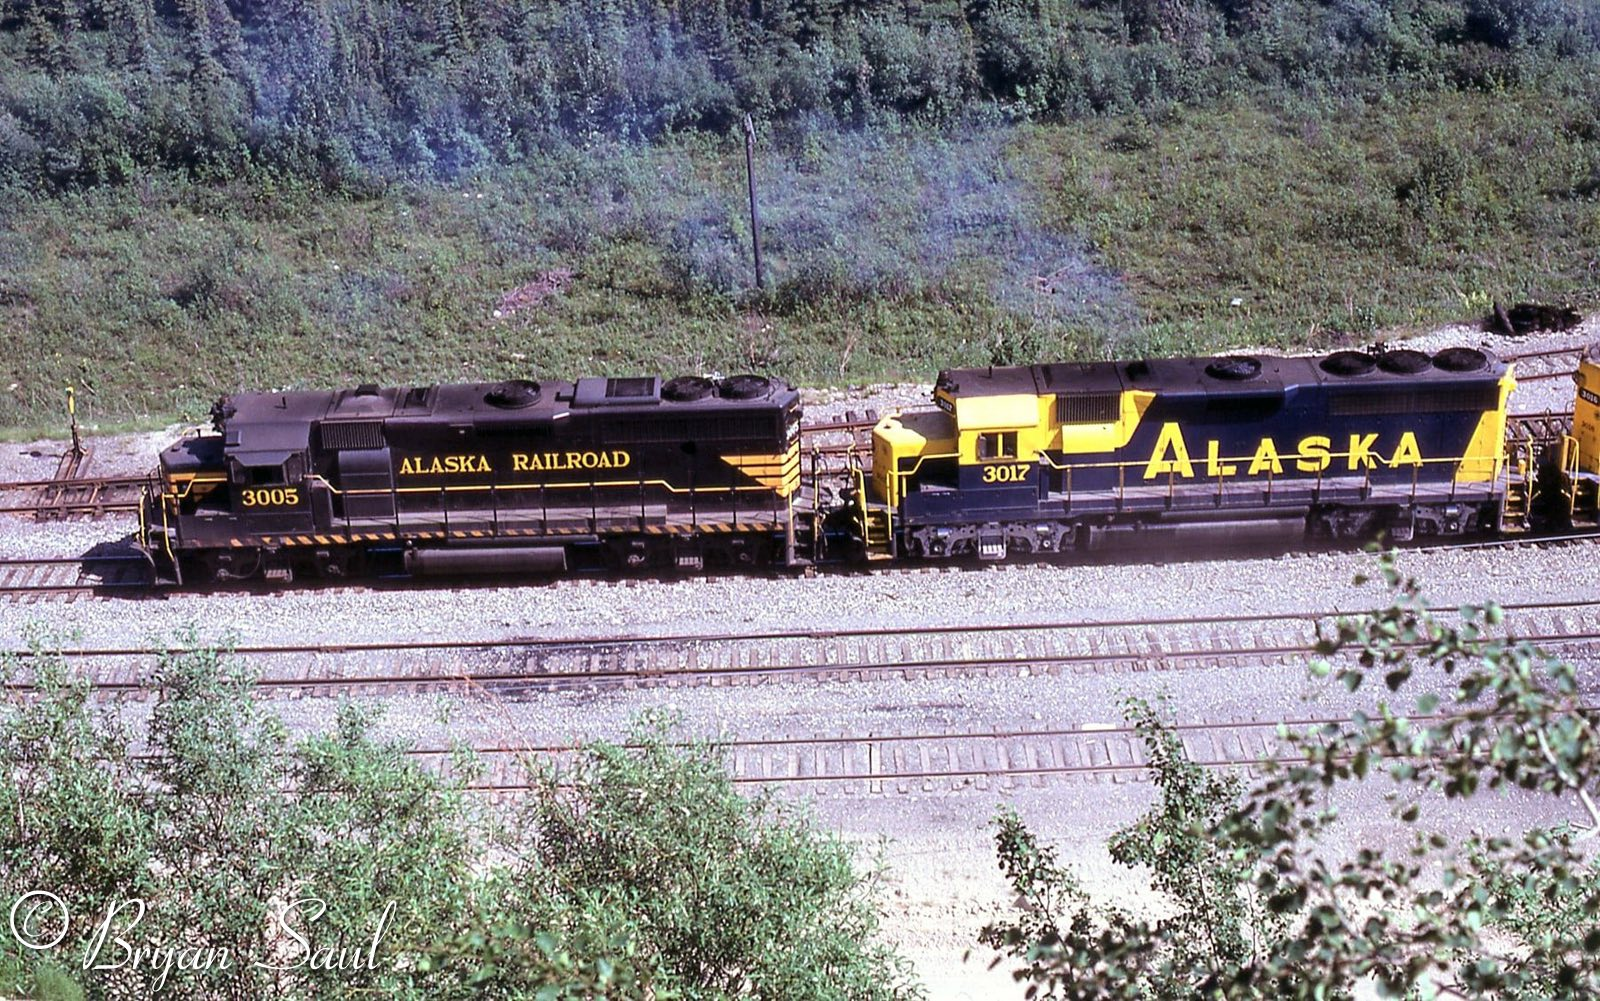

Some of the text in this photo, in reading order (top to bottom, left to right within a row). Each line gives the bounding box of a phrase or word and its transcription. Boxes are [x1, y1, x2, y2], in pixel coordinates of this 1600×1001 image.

[1143, 422, 1423, 480] ALASKA
[400, 450, 631, 475] ALASKA RAILROAD
[982, 464, 1031, 483] 3017
[241, 488, 299, 507] 3005
